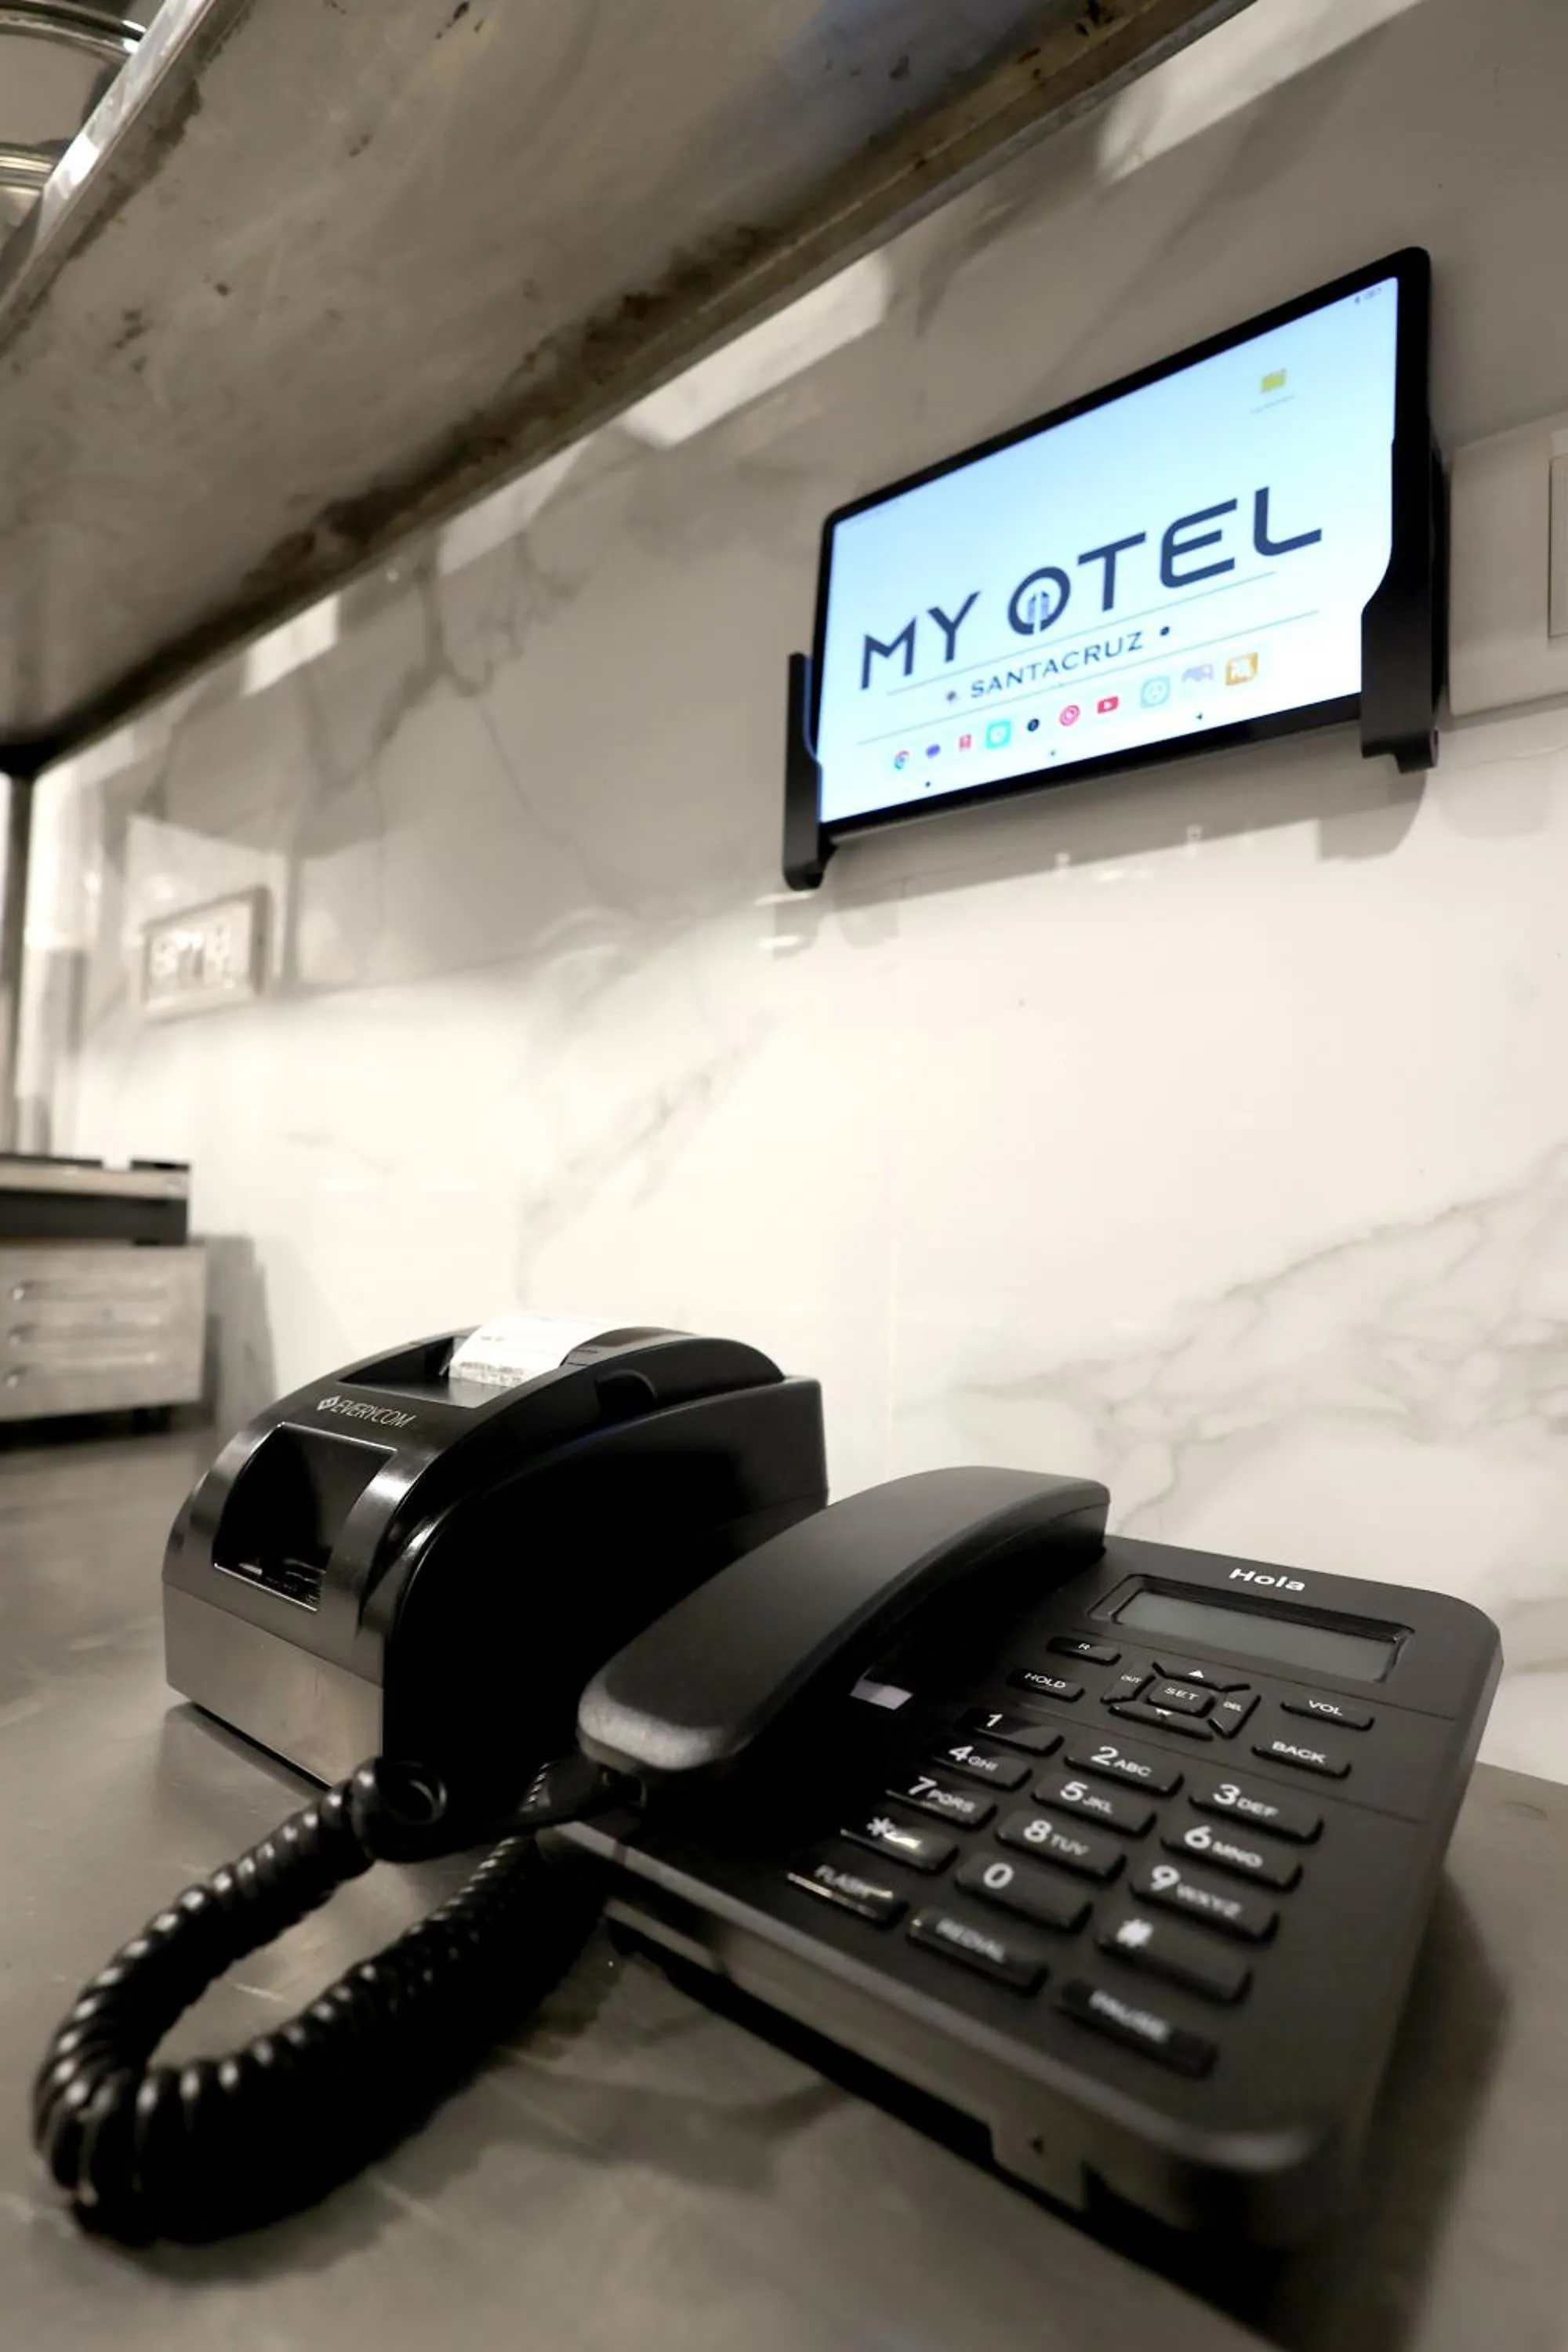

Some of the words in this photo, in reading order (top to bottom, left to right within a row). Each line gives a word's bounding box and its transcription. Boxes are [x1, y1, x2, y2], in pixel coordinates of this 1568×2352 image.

[861, 590, 981, 690] MY
[1007, 486, 1322, 635] OTEL
[970, 631, 1143, 699] SANTACRUZ
[334, 1399, 417, 1428] EVERYCOM
[1229, 1567, 1306, 1592] Hola
[1024, 1671, 1066, 1689] HOLD
[1120, 1674, 1142, 1683] OUT
[1162, 1686, 1200, 1701] SET
[1223, 1700, 1243, 1712] DEL
[1308, 1699, 1343, 1717] VOL
[986, 1713, 1004, 1727] 1
[1271, 1740, 1327, 1764] BACK
[983, 1862, 1015, 1889] 0
